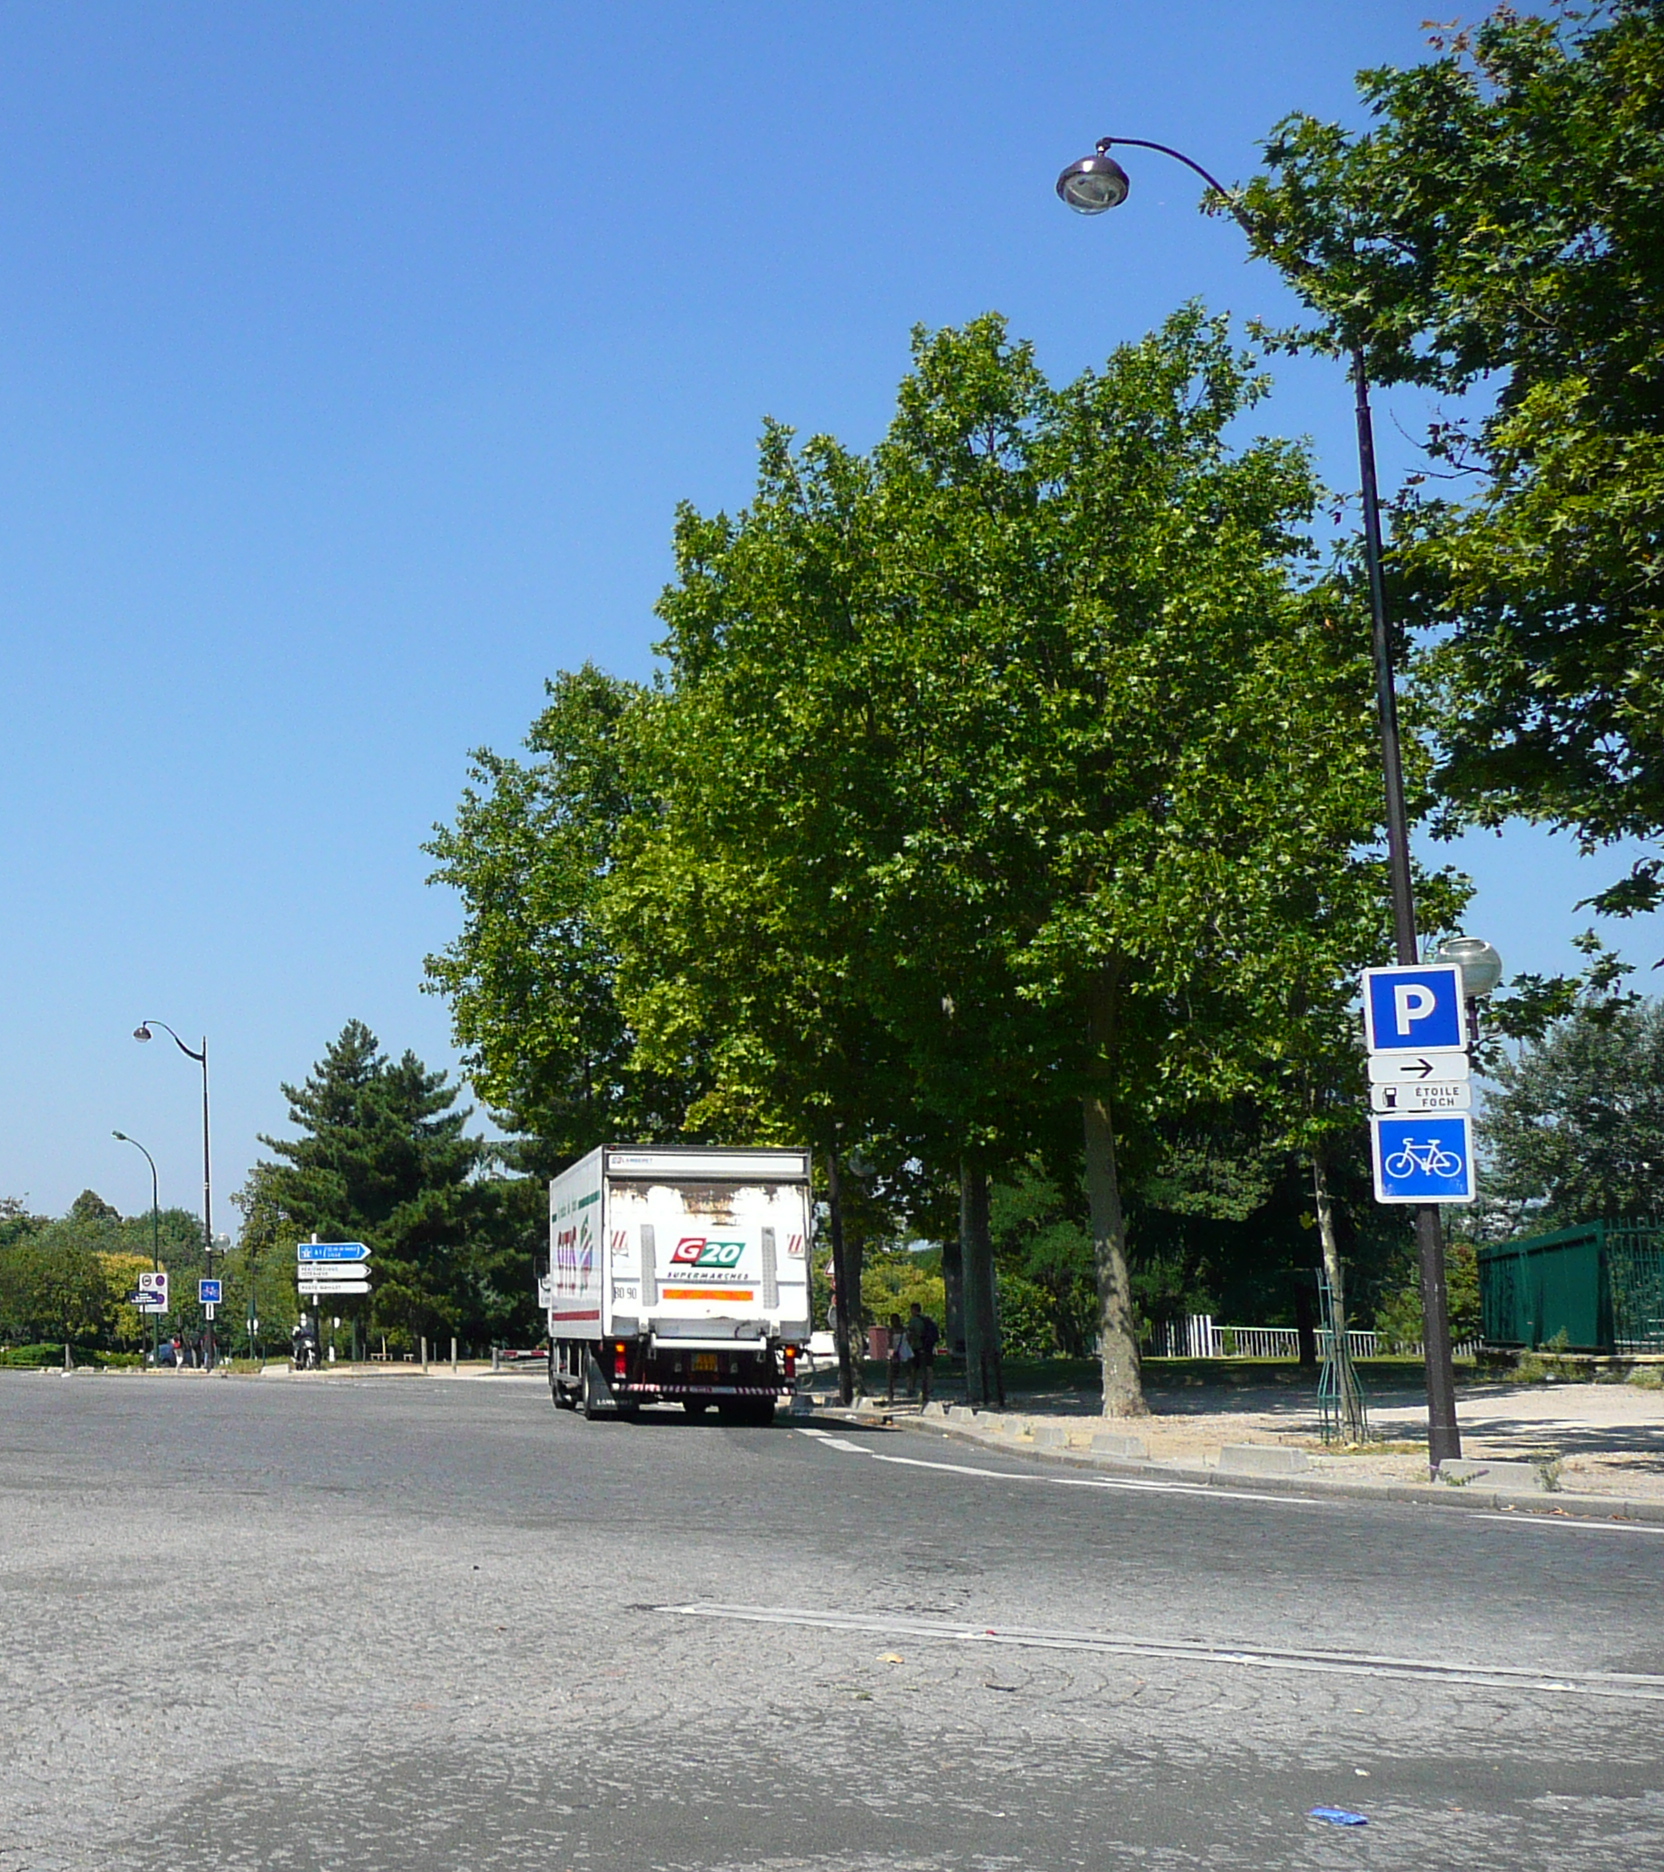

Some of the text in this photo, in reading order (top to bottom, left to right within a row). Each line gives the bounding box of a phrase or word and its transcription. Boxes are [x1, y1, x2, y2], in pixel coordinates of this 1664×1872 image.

[1394, 984, 1435, 1035] P
[1415, 1086, 1460, 1097] ÉTOILE
[1422, 1098, 1455, 1107] FOCH
